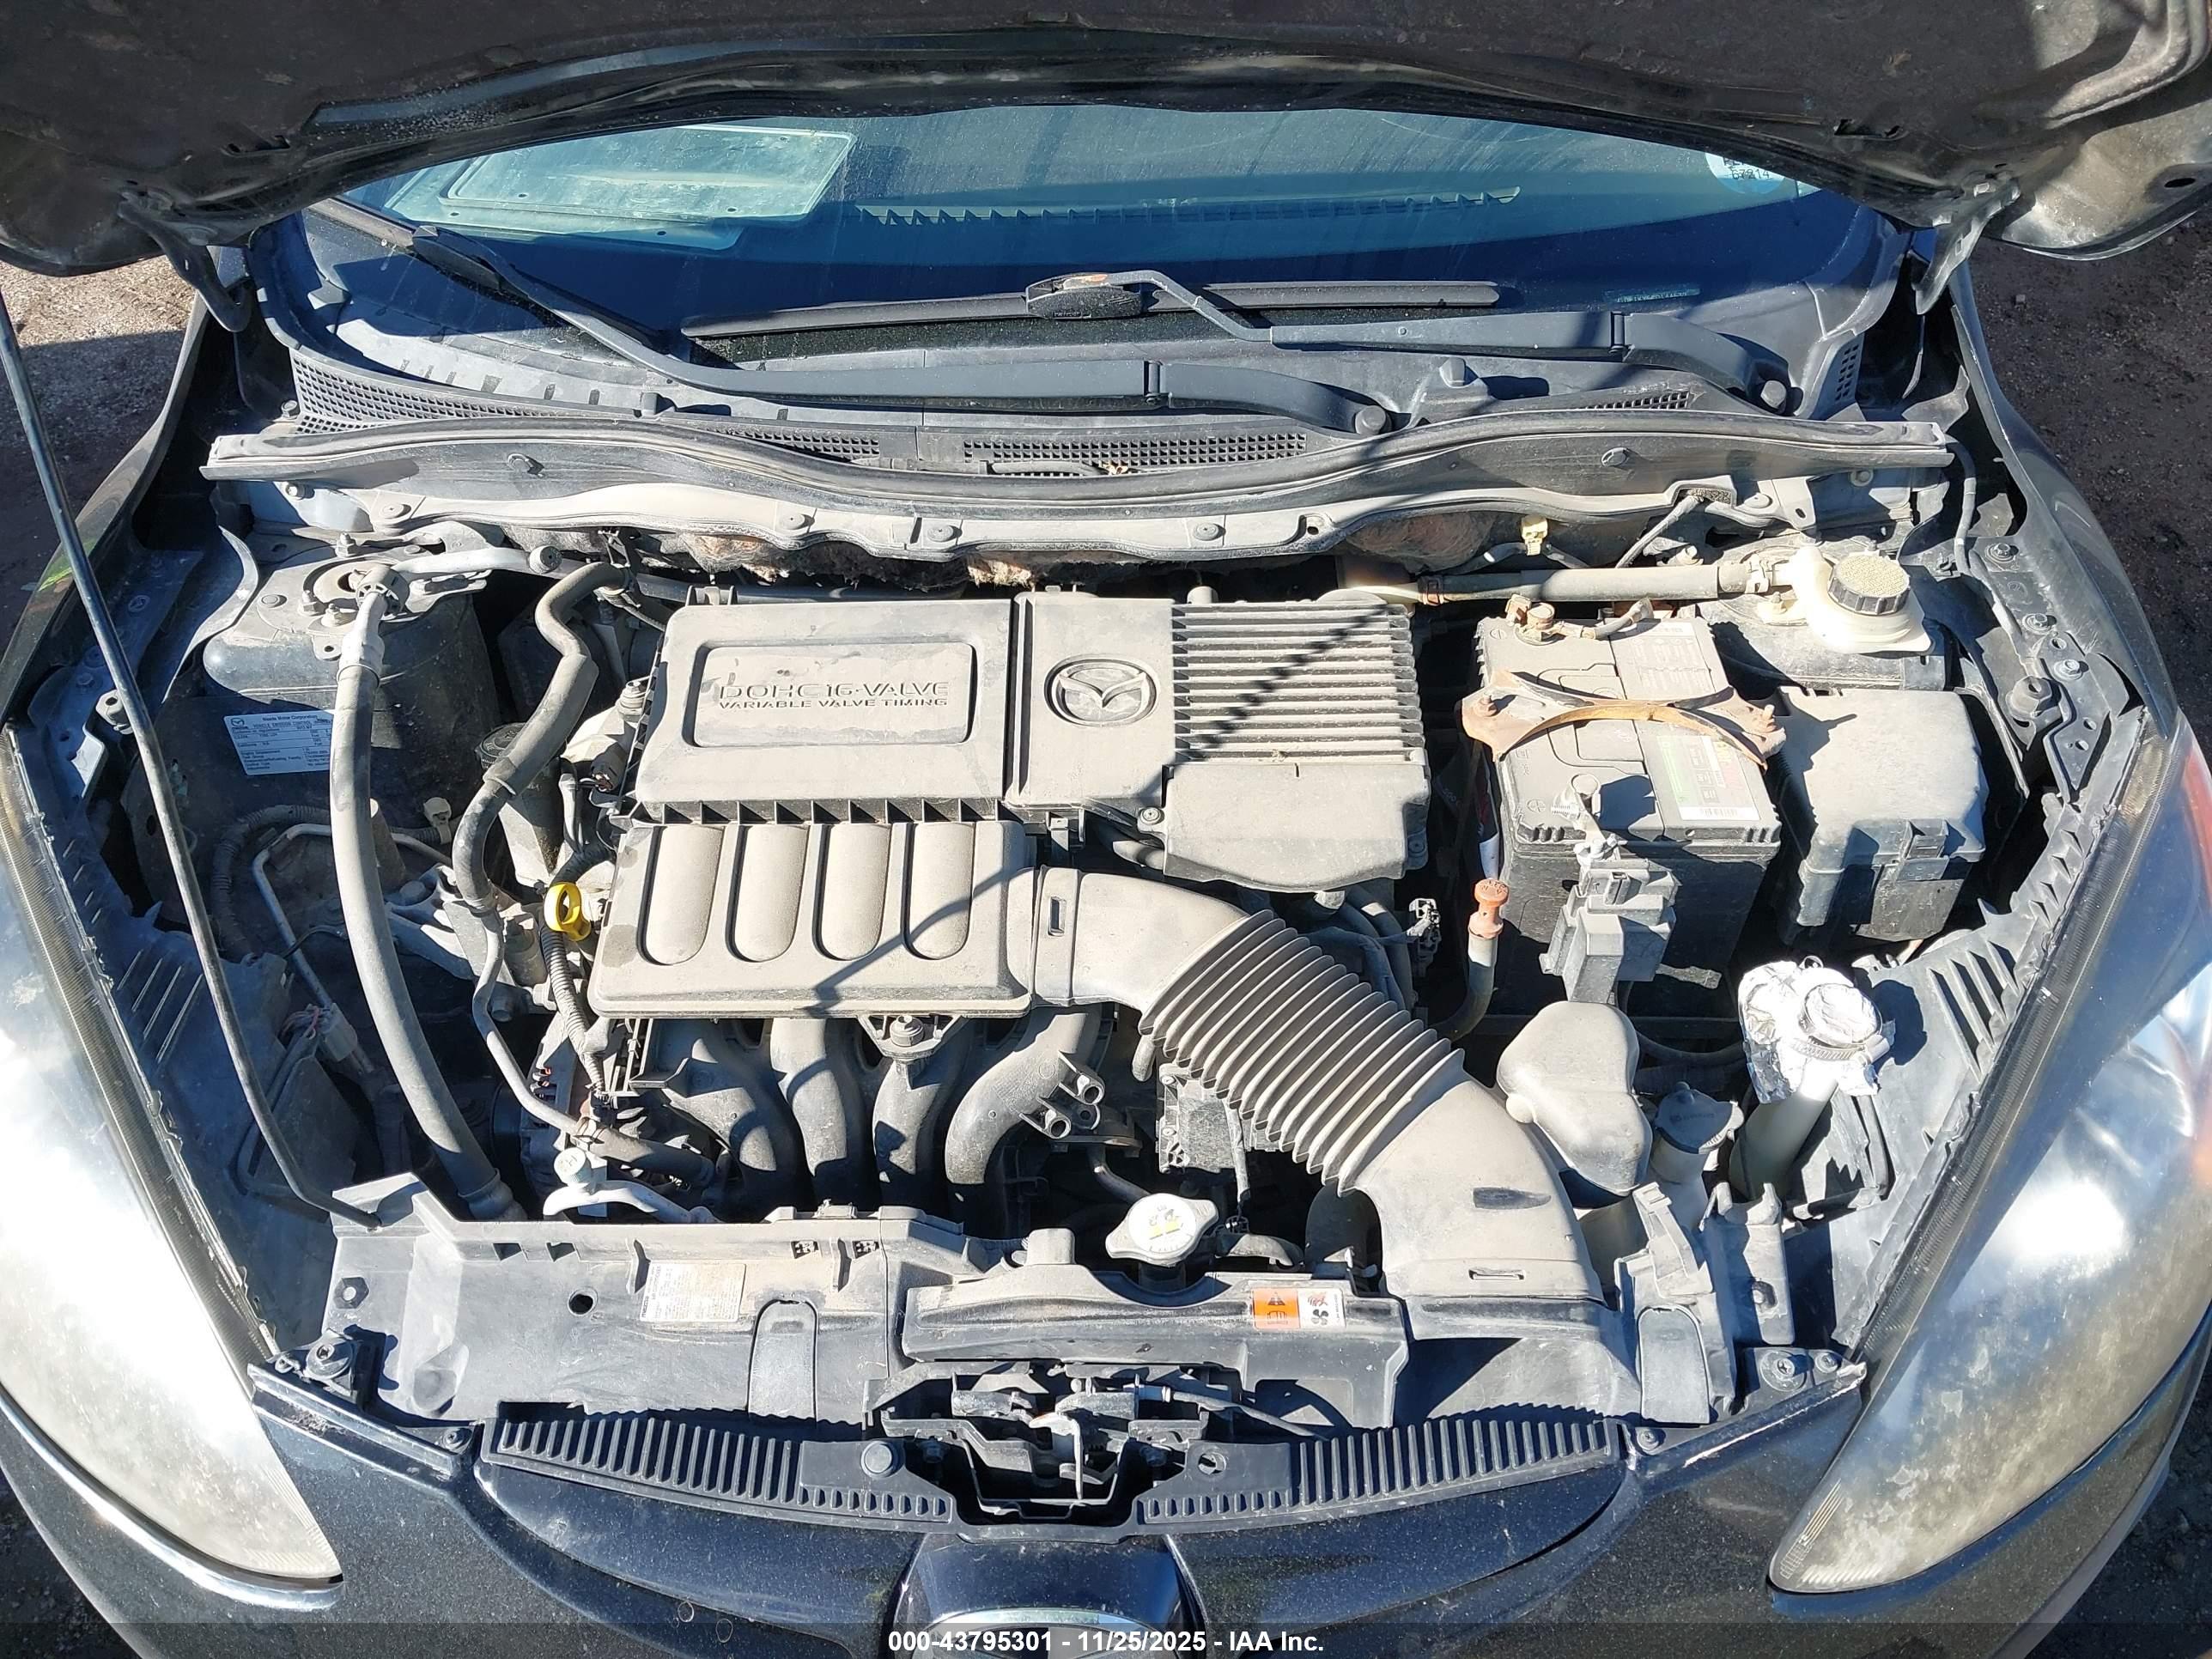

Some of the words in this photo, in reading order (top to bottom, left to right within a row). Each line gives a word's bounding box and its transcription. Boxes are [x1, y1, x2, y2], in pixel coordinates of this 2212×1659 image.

[720, 684, 819, 700] DOHC
[720, 700, 811, 708] VARIABLE
[818, 699, 876, 708] VALVE
[881, 698, 948, 707] TIMING
